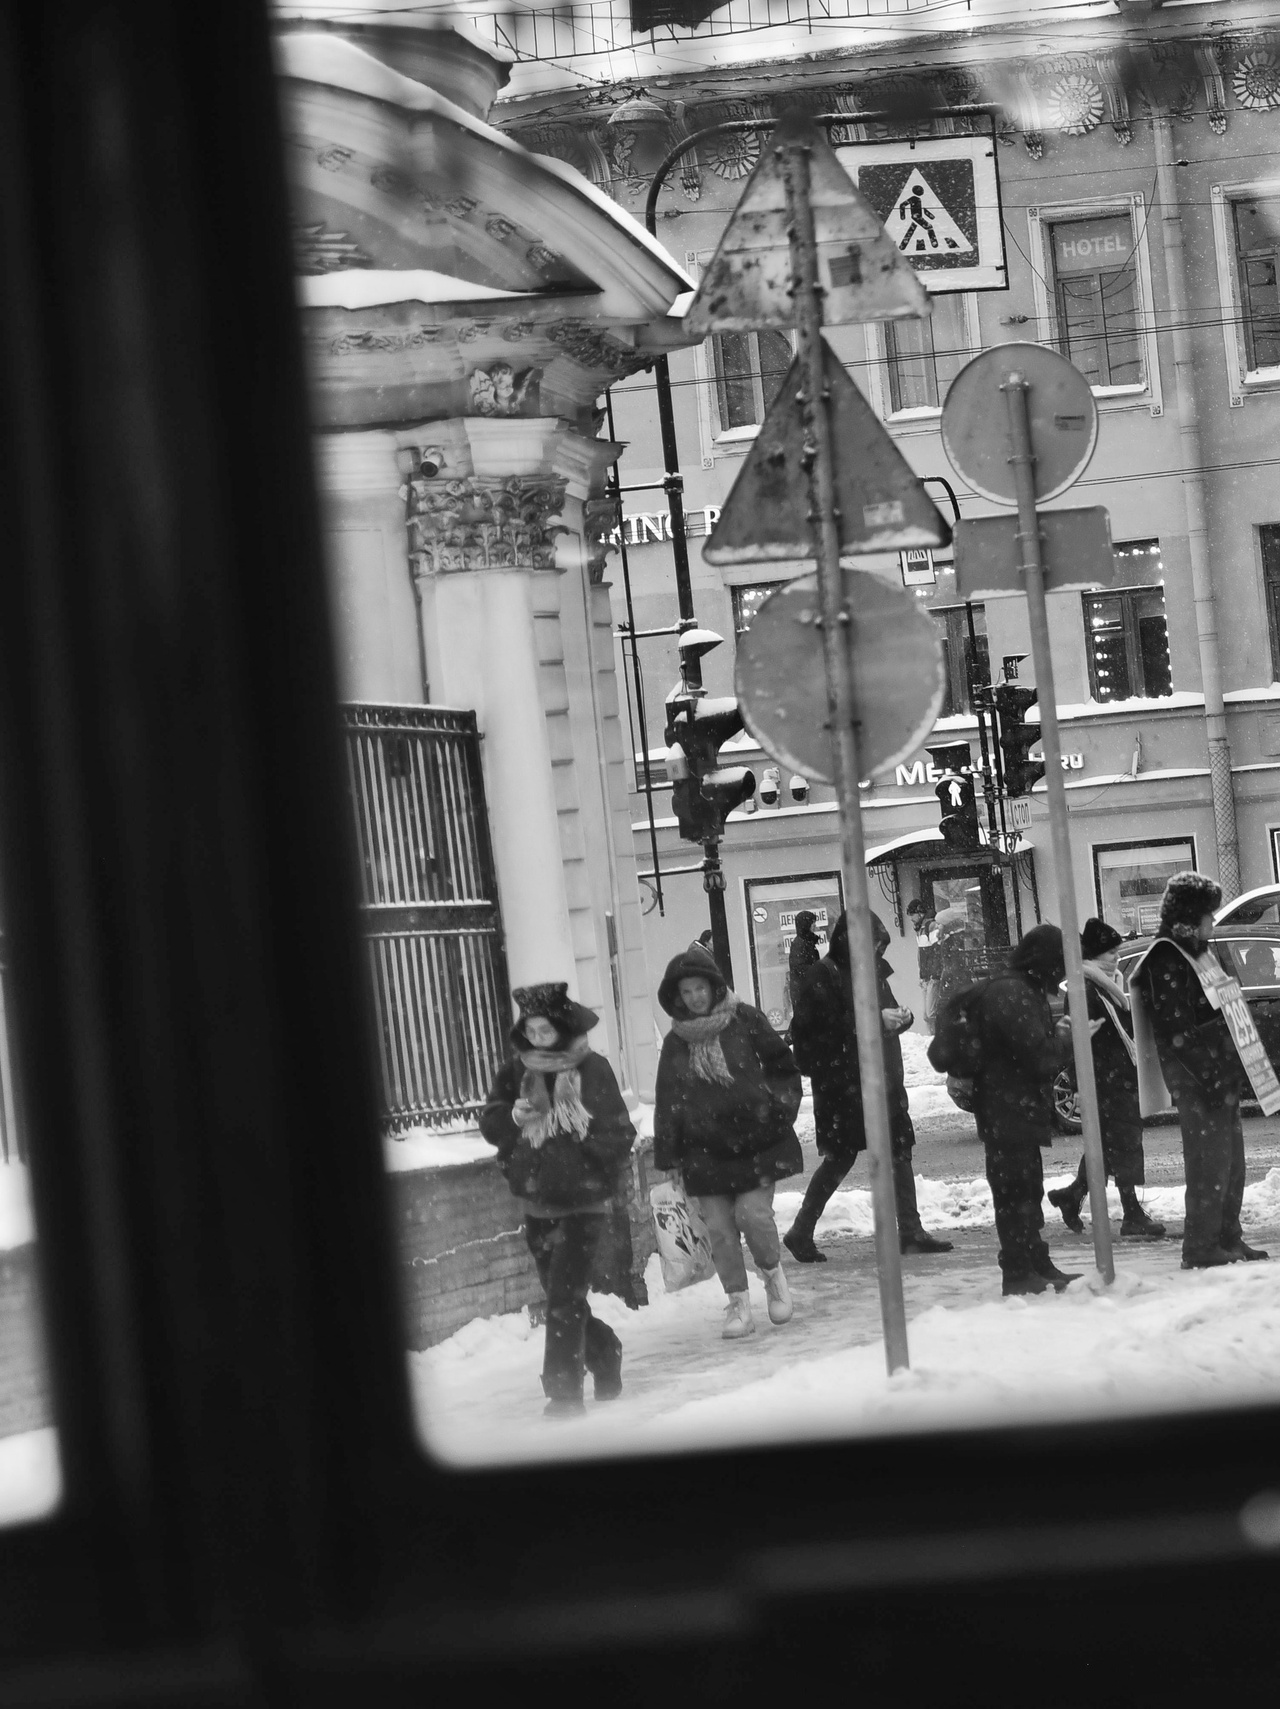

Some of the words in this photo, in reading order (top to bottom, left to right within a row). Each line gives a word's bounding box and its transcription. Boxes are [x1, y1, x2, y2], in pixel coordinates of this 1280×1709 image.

[1062, 235, 1127, 258] HOTEL
[1013, 802, 1030, 825] СТОП
[781, 910, 827, 926] ДЕНЫЕ
